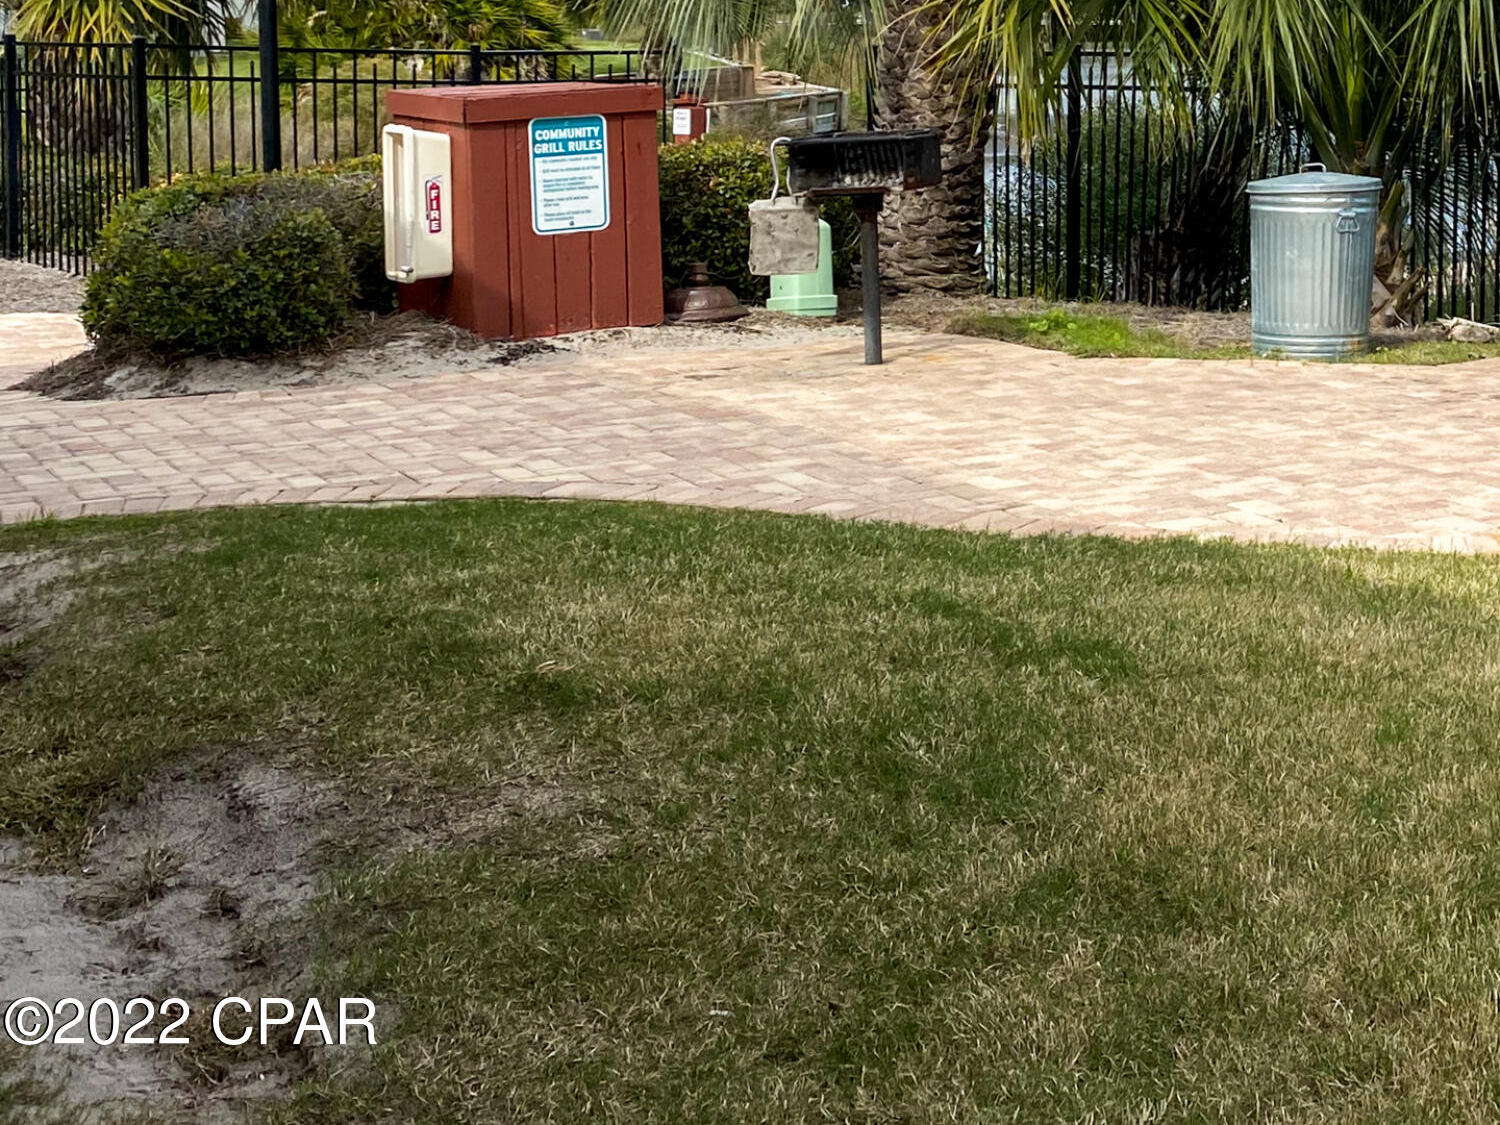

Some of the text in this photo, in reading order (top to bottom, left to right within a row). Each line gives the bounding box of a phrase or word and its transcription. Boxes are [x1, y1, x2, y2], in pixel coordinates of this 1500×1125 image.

[534, 126, 600, 141] COMMUNITY
[534, 139, 603, 154] GRILL RULES
[430, 189, 440, 231] FIRE
